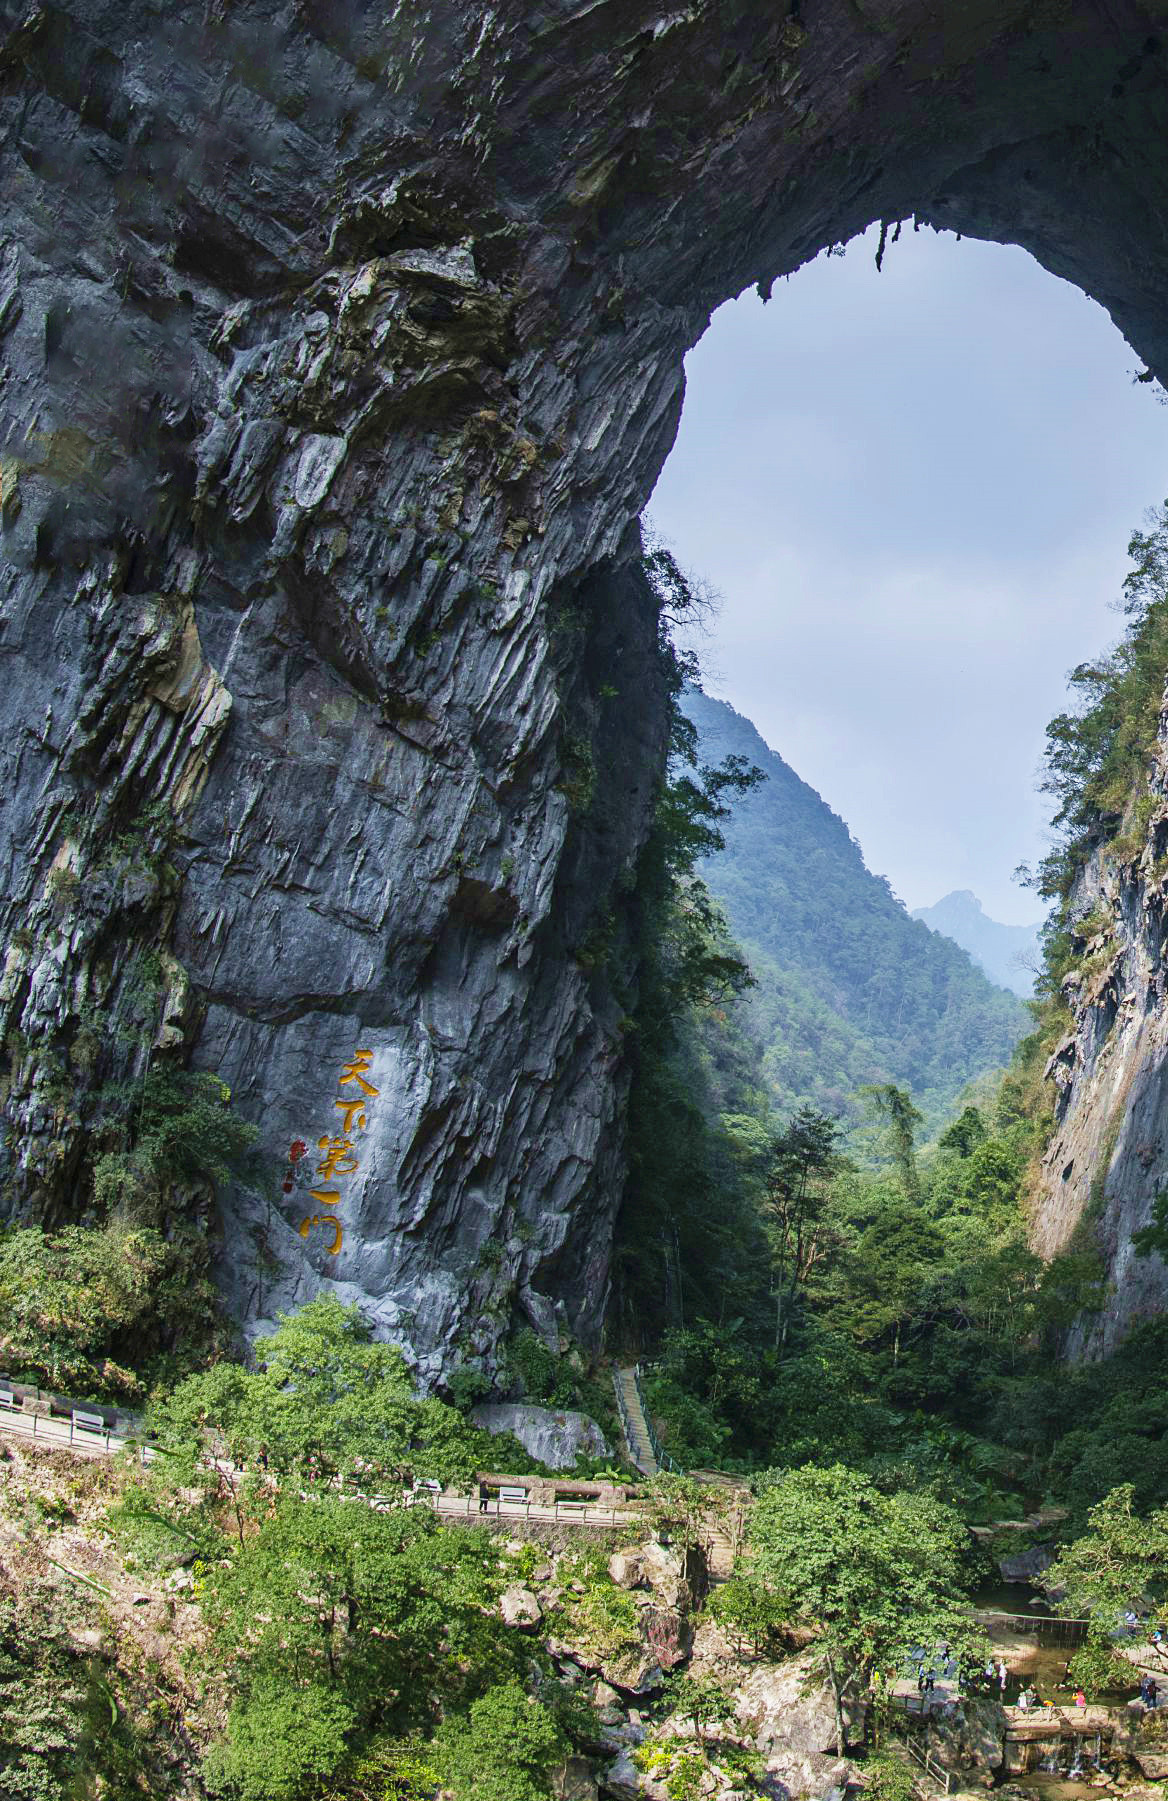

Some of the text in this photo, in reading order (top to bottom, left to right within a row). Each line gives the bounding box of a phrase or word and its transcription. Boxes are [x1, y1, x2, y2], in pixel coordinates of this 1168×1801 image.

[299, 1049, 380, 1256] 天下第一门
